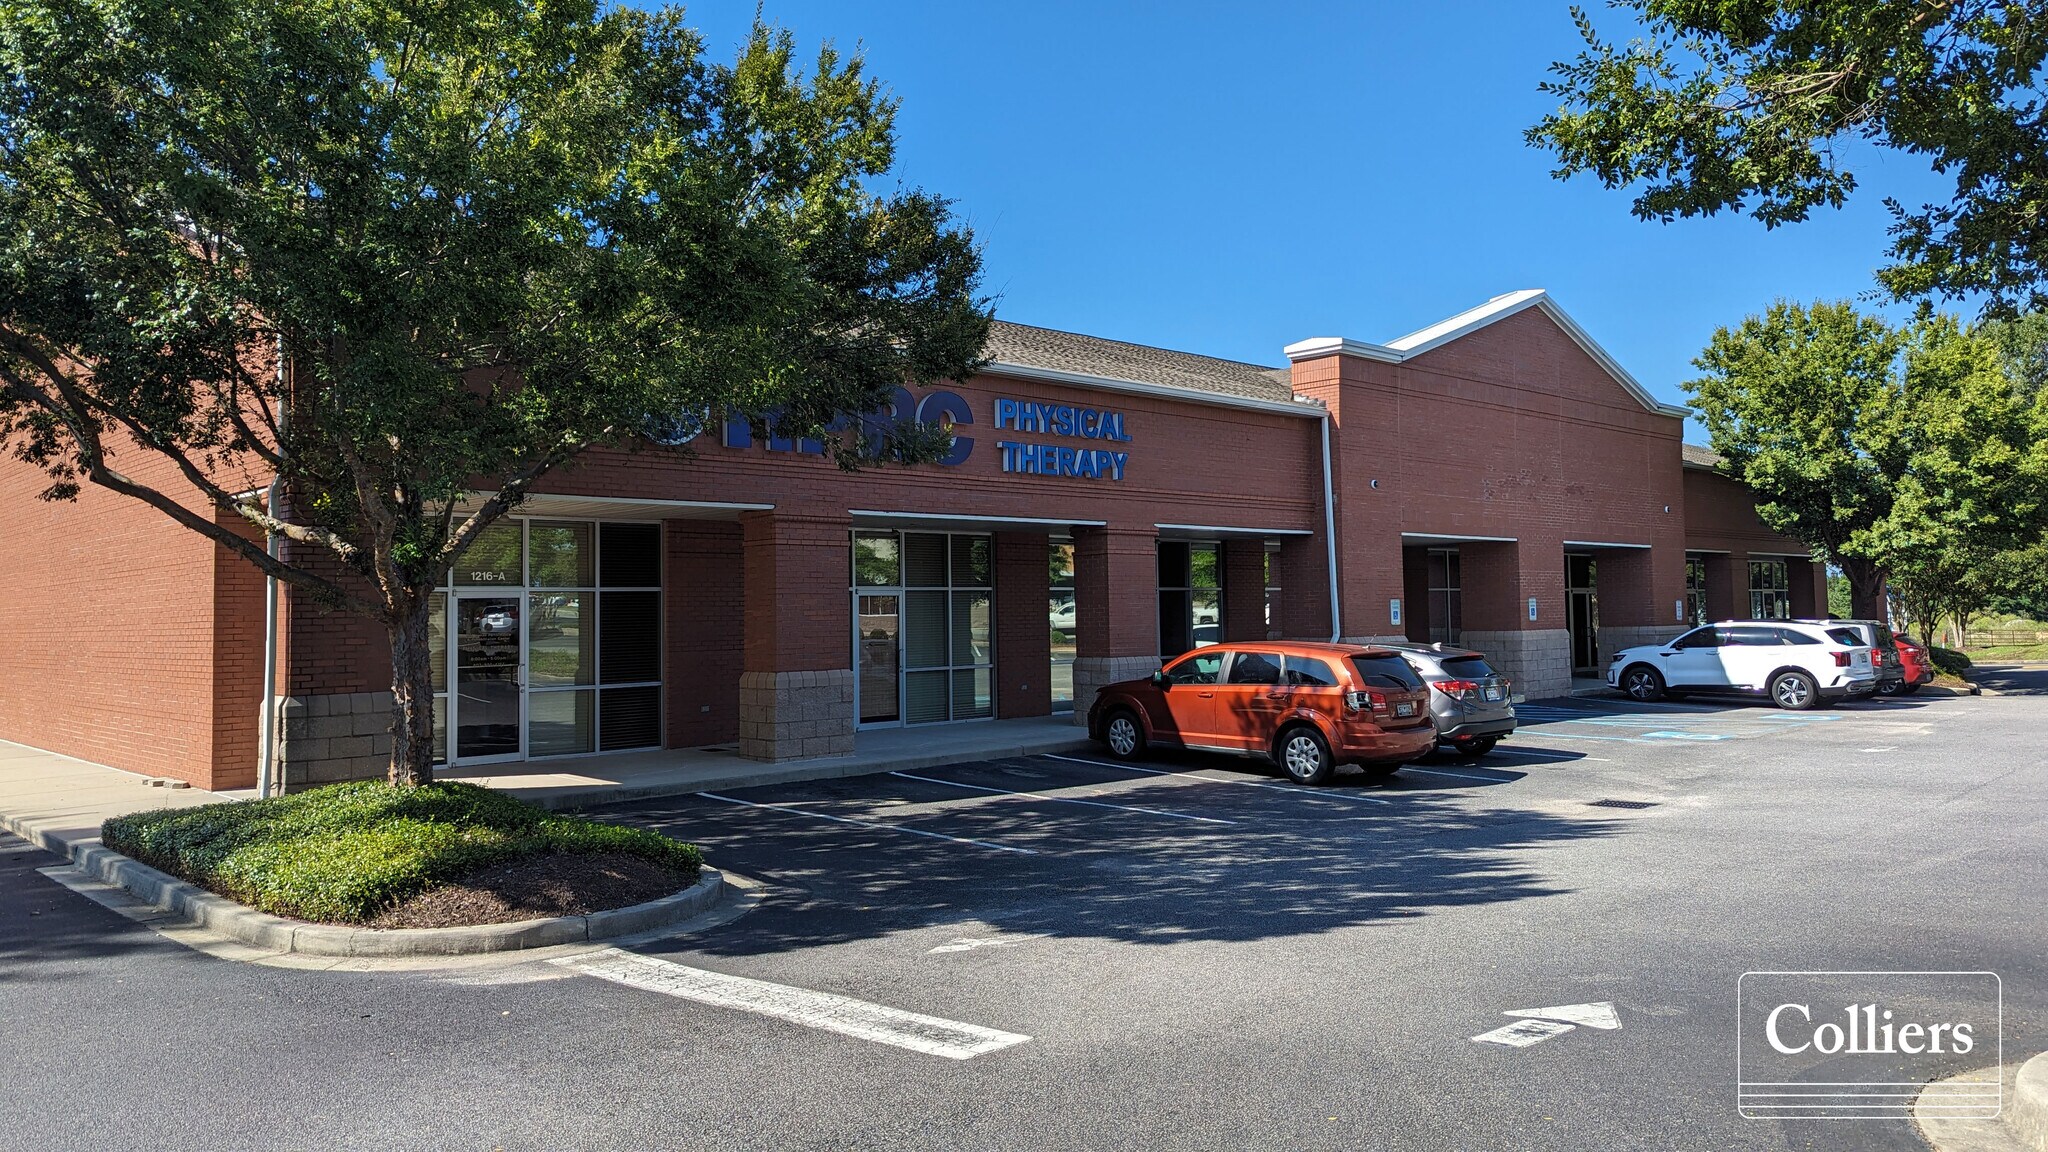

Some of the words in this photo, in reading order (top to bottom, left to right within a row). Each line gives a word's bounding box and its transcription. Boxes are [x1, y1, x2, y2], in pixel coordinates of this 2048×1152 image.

[994, 398, 1133, 442] PHYSICAL
[997, 441, 1129, 480] THERAPY
[471, 571, 506, 582] 1216-A
